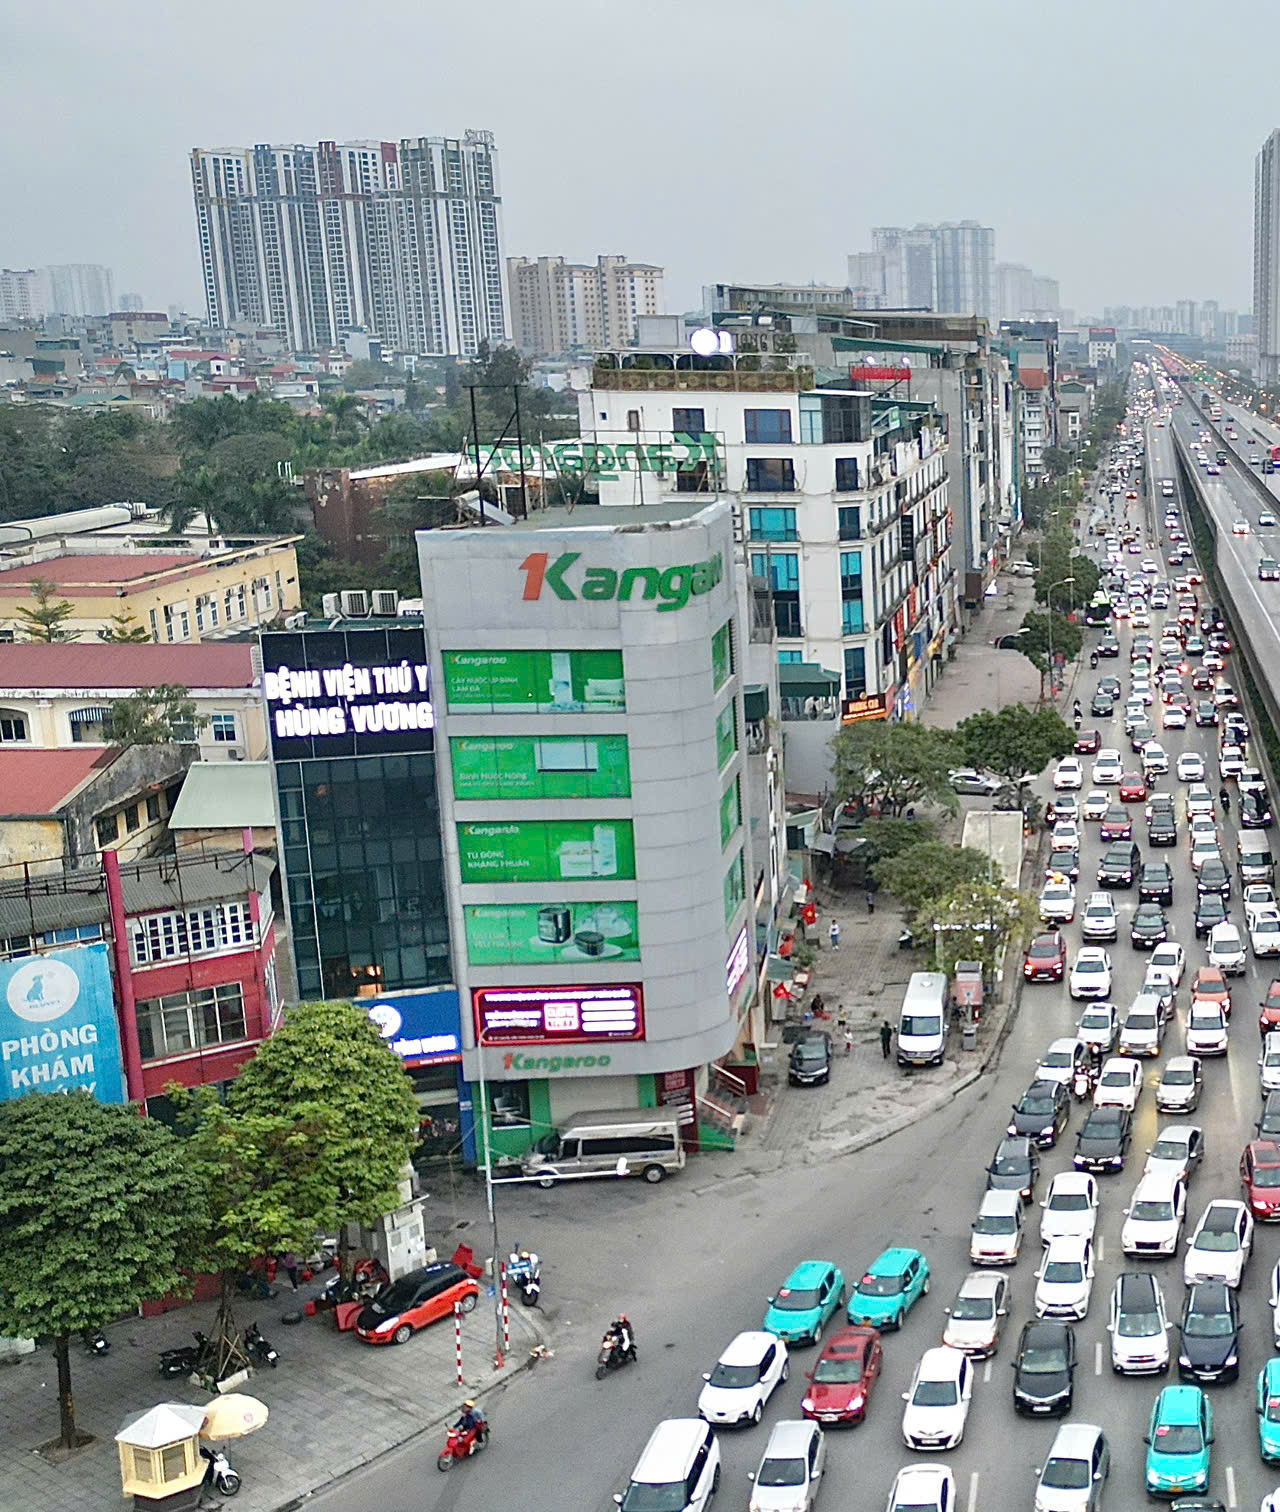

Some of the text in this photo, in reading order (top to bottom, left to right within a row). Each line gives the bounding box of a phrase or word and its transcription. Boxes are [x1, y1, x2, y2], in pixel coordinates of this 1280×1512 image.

[264, 660, 428, 705] BỆNH VIỆN THÚ Y
[276, 701, 434, 737] HÙNG VƯƠNG
[1, 1023, 98, 1062] PHÒNG
[11, 1054, 95, 1089] KHÁM
[503, 1052, 611, 1072] Kangaroo
